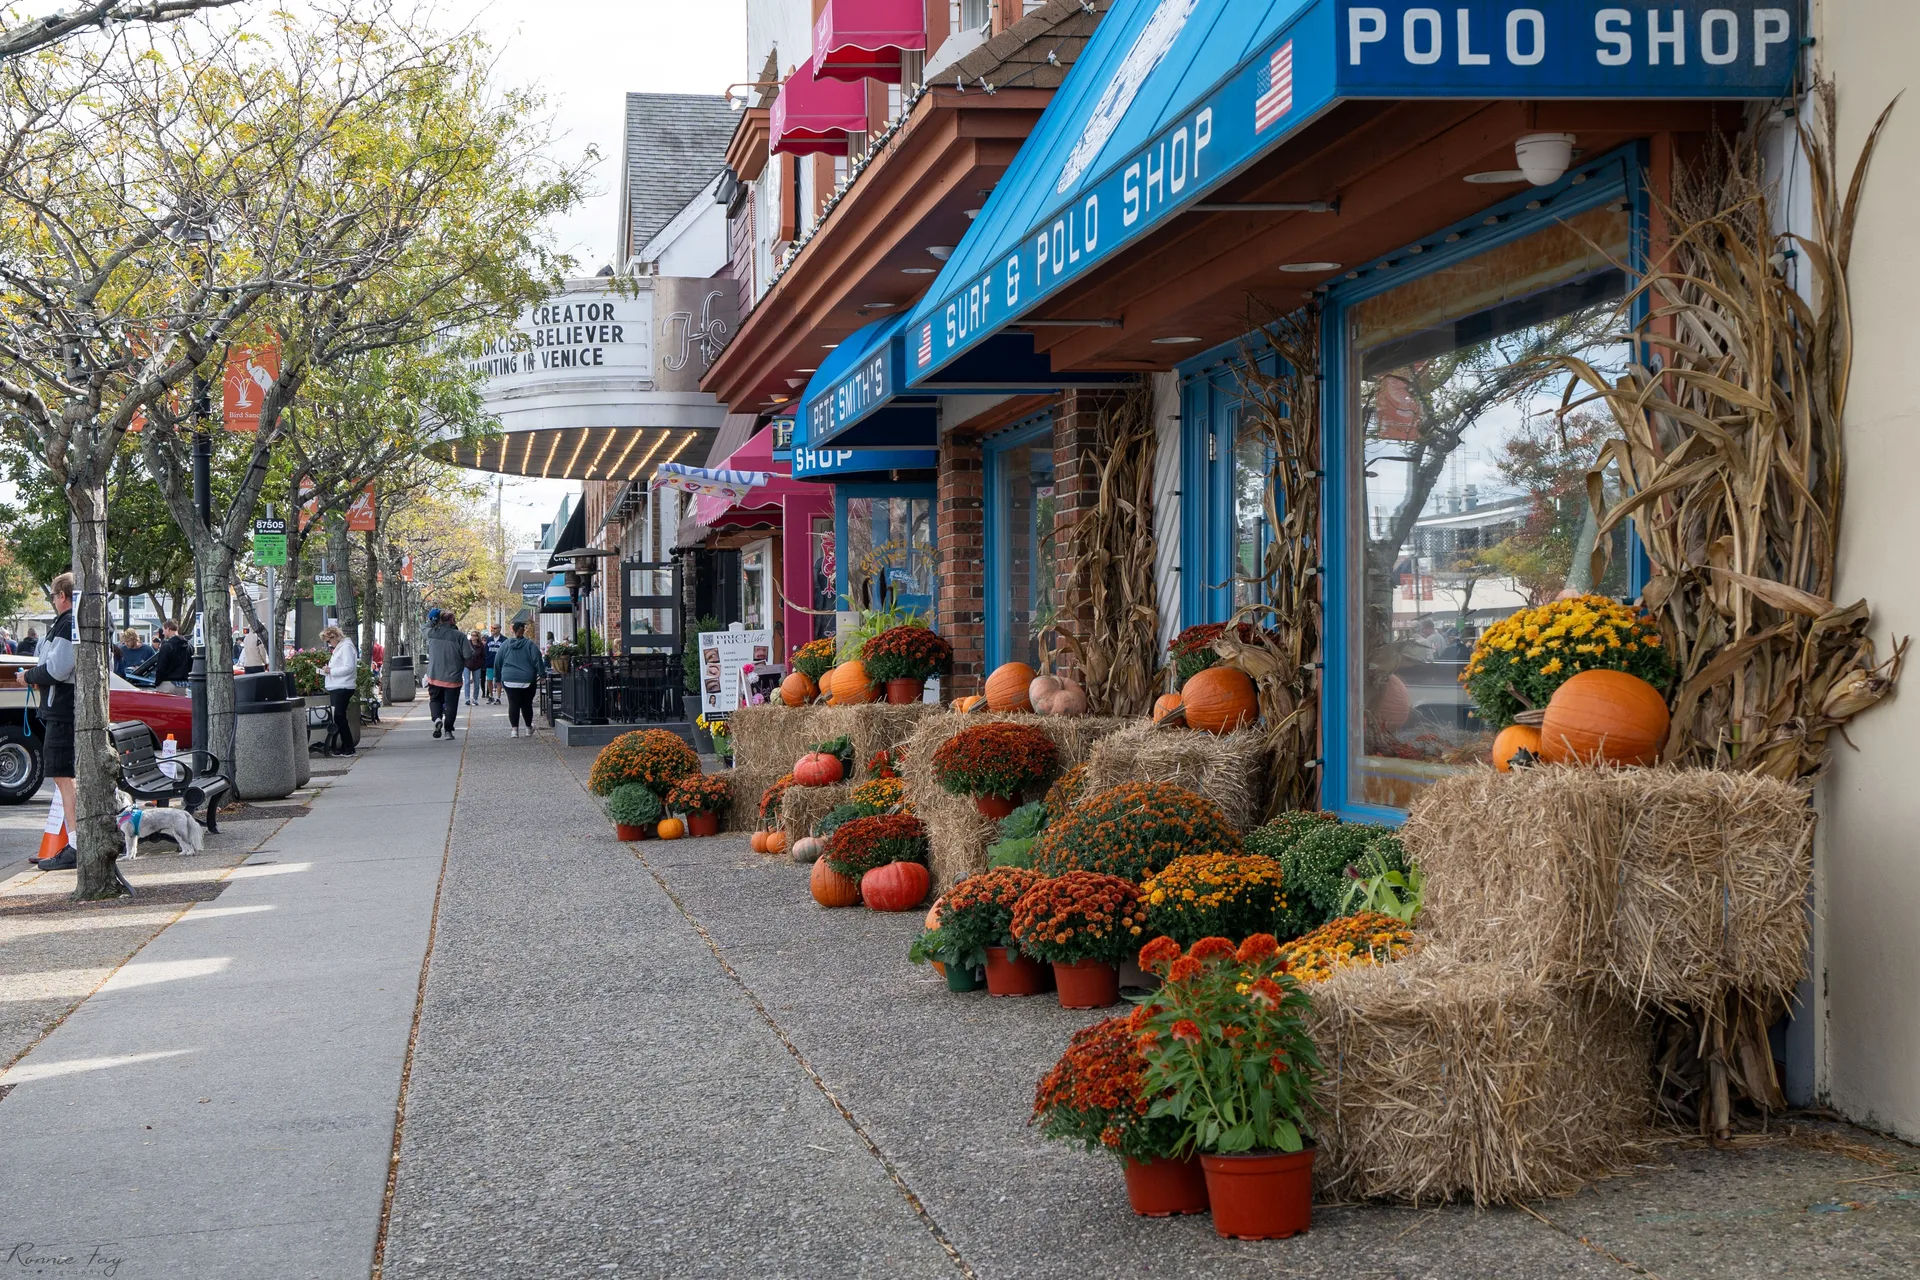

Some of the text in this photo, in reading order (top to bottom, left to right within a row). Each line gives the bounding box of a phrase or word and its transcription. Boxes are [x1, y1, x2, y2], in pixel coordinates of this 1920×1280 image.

[1348, 7, 1790, 67] POLO SHOP
[945, 107, 1213, 348] SURF & POLO SHOP
[532, 303, 615, 326] CREATOR
[536, 325, 624, 348] BELIEVER
[523, 352, 535, 372] IN
[541, 347, 604, 369] VENICE
[813, 358, 883, 438] PETE SMITH'S
[795, 447, 853, 472] SHOP
[256, 521, 284, 529] 87505
[716, 632, 767, 645] PRICE List
